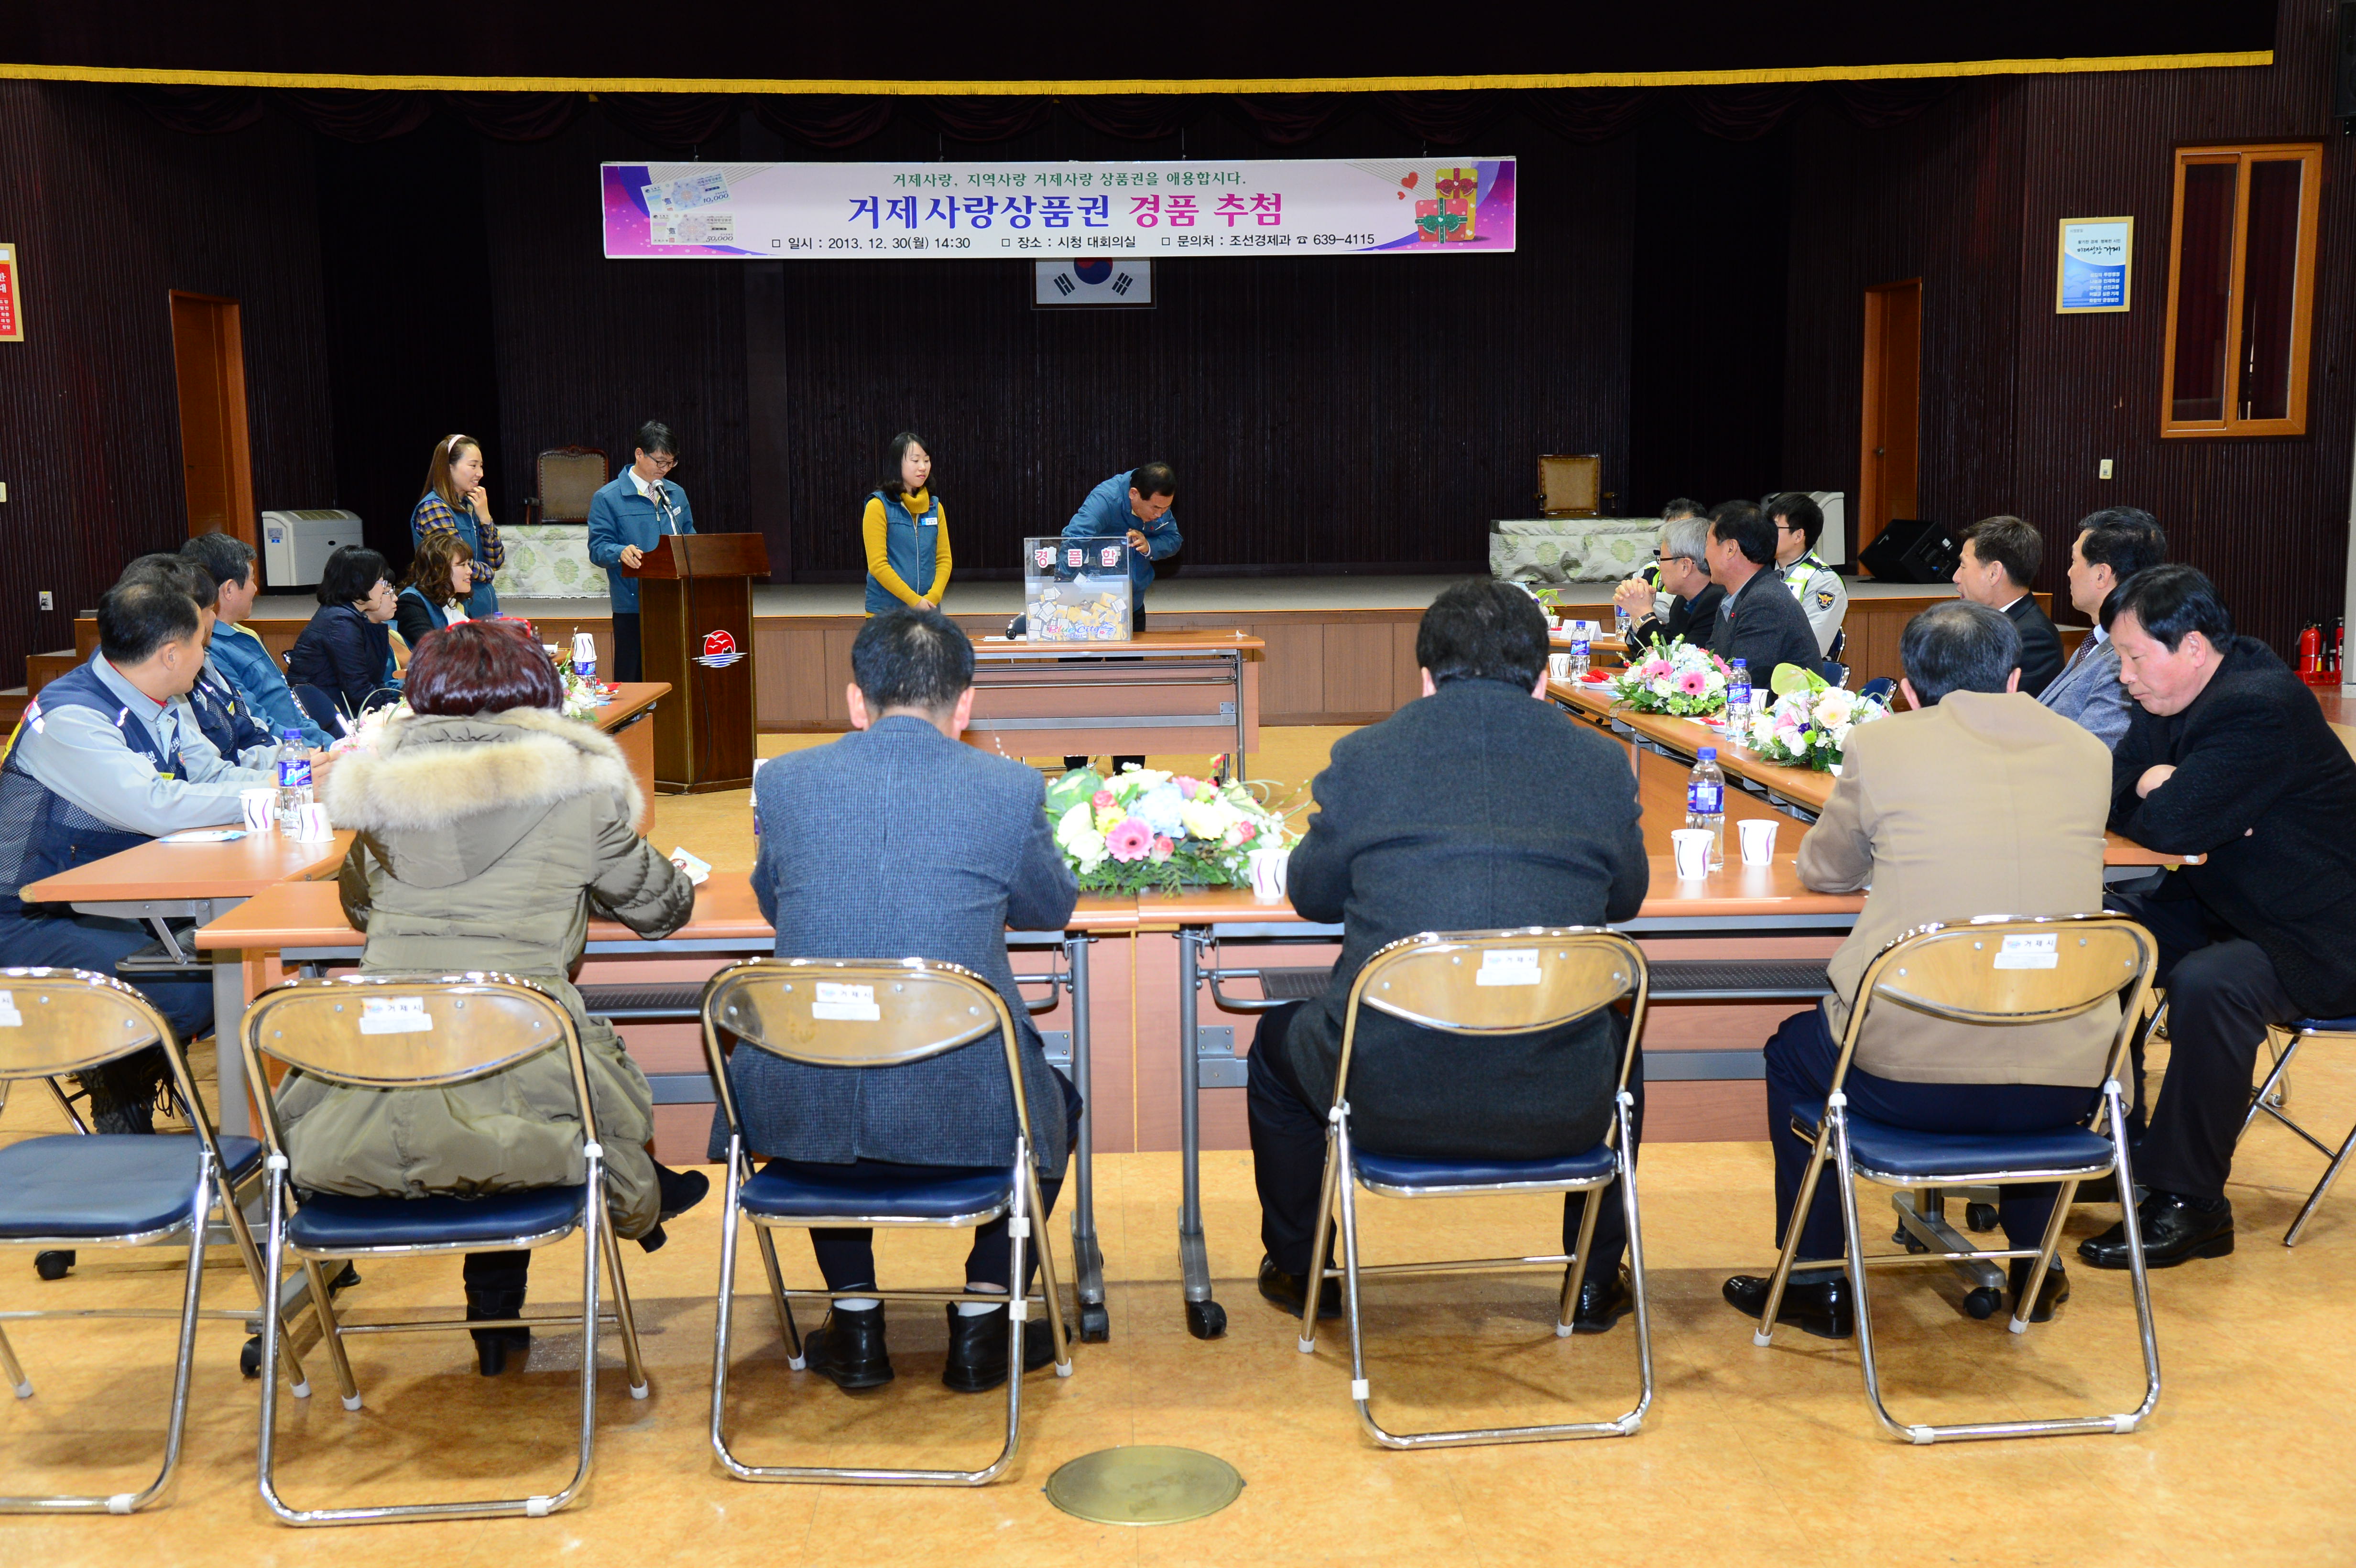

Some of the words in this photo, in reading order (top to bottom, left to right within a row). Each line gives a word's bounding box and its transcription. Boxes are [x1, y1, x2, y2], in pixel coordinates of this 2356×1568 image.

[894, 174, 957, 187] 거제사랑,
[968, 173, 1026, 187] 지역사랑
[1035, 173, 1093, 187] 거제사랑
[1100, 172, 1159, 186] 상품권을
[1167, 171, 1246, 186] 애용합시다.
[704, 193, 729, 203] 10,000
[848, 195, 1109, 229] 거제사랑상품권
[1129, 194, 1200, 228] 경품
[1213, 193, 1282, 227] 추첨
[788, 238, 812, 250] 일시
[828, 238, 862, 249] 2013.
[868, 238, 887, 249] 12.
[892, 236, 929, 250] 30(월)
[935, 237, 971, 249] 14:30
[1017, 236, 1042, 249] 장소
[1058, 236, 1082, 249] 시청
[1087, 235, 1136, 248] 대회의실
[1177, 235, 1214, 247] 문의처
[1229, 234, 1291, 247] 조선경제과
[1313, 233, 1375, 245] 639-4115
[2077, 246, 2102, 254] 미래성장
[2104, 246, 2120, 255] 거제
[1077, 625, 1100, 633] City
[1729, 687, 1746, 698] 퓨리스
